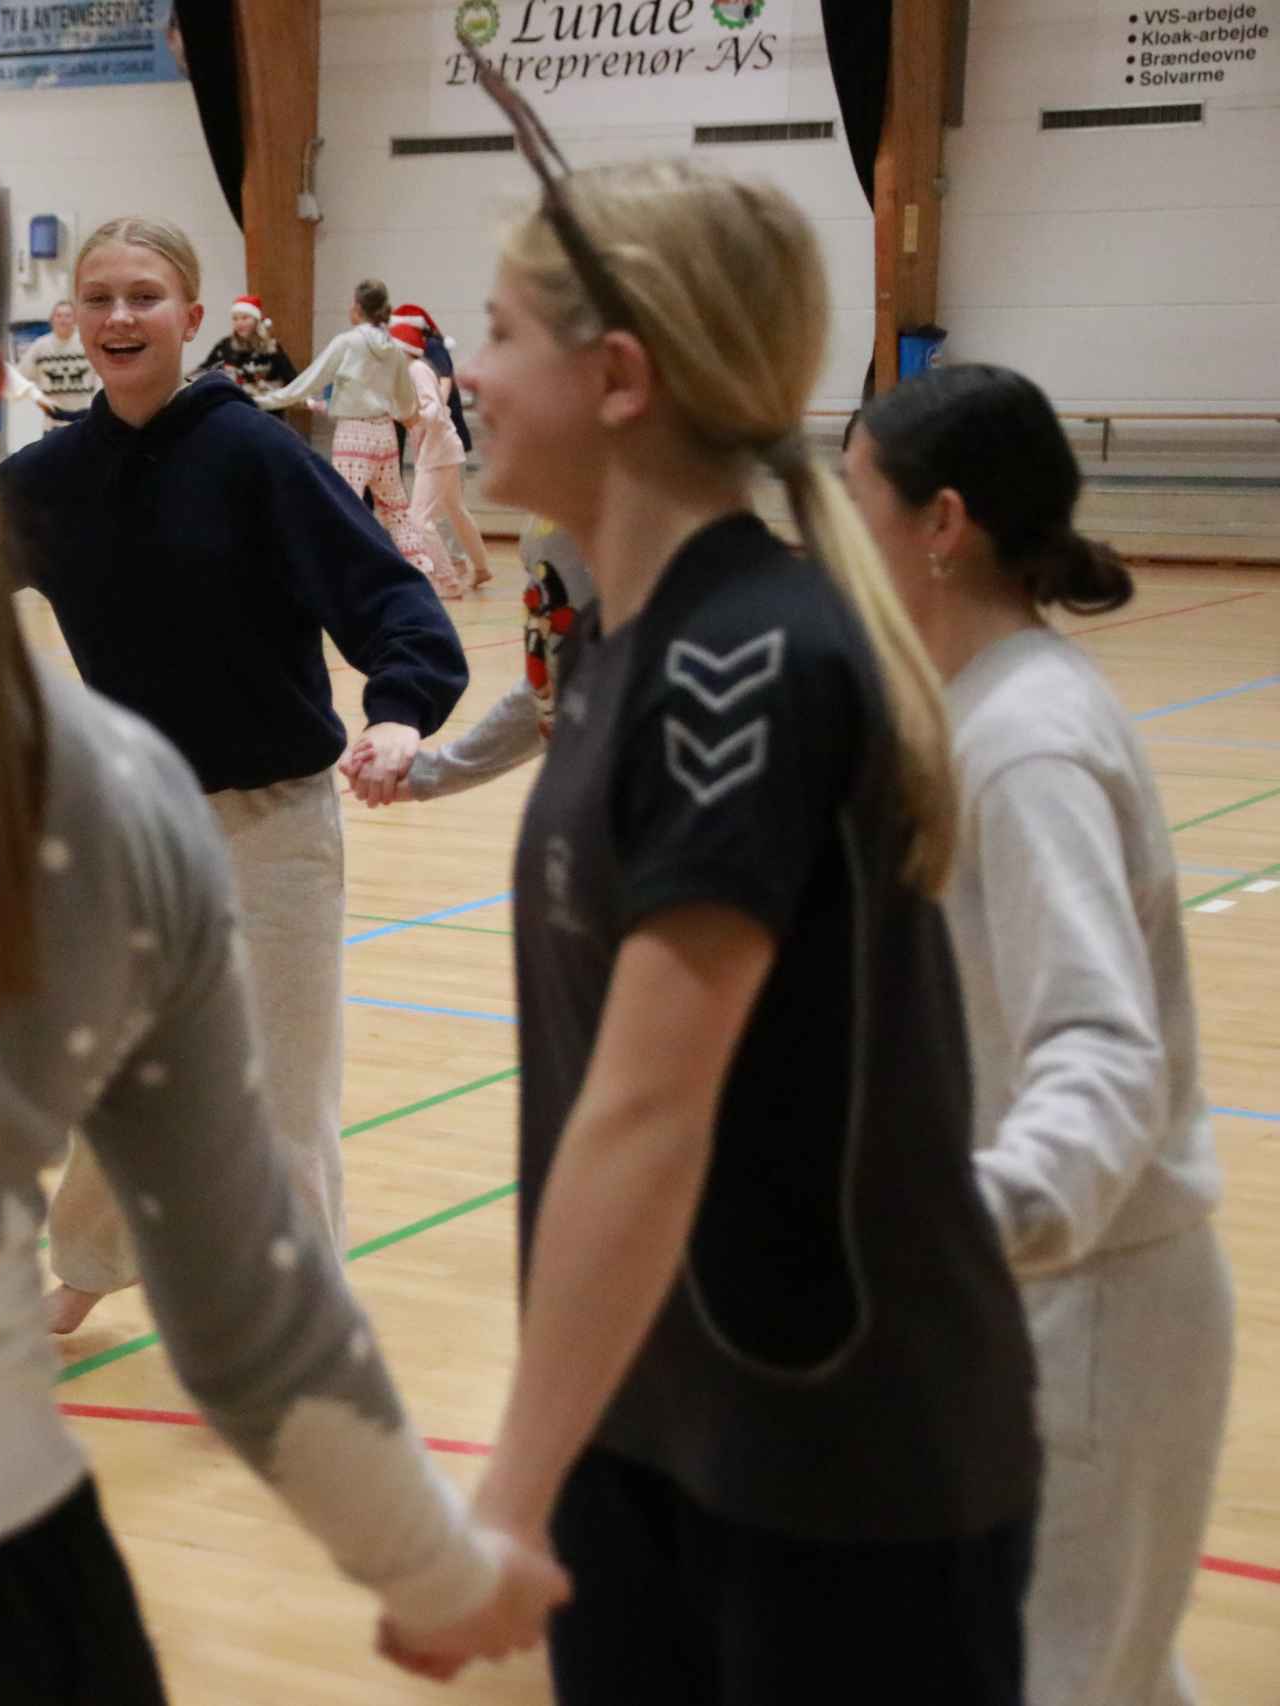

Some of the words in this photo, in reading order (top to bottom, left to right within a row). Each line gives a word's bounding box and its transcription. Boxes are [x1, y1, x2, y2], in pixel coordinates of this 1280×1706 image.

[510, 0, 695, 43] Lunde
[1143, 4, 1257, 25] VVS-arbejde
[1140, 24, 1270, 46] Kloak-arbejde
[1139, 47, 1257, 67] Brændeovne
[445, 46, 695, 95] Entreprenør
[1138, 68, 1225, 87] Solvarme
